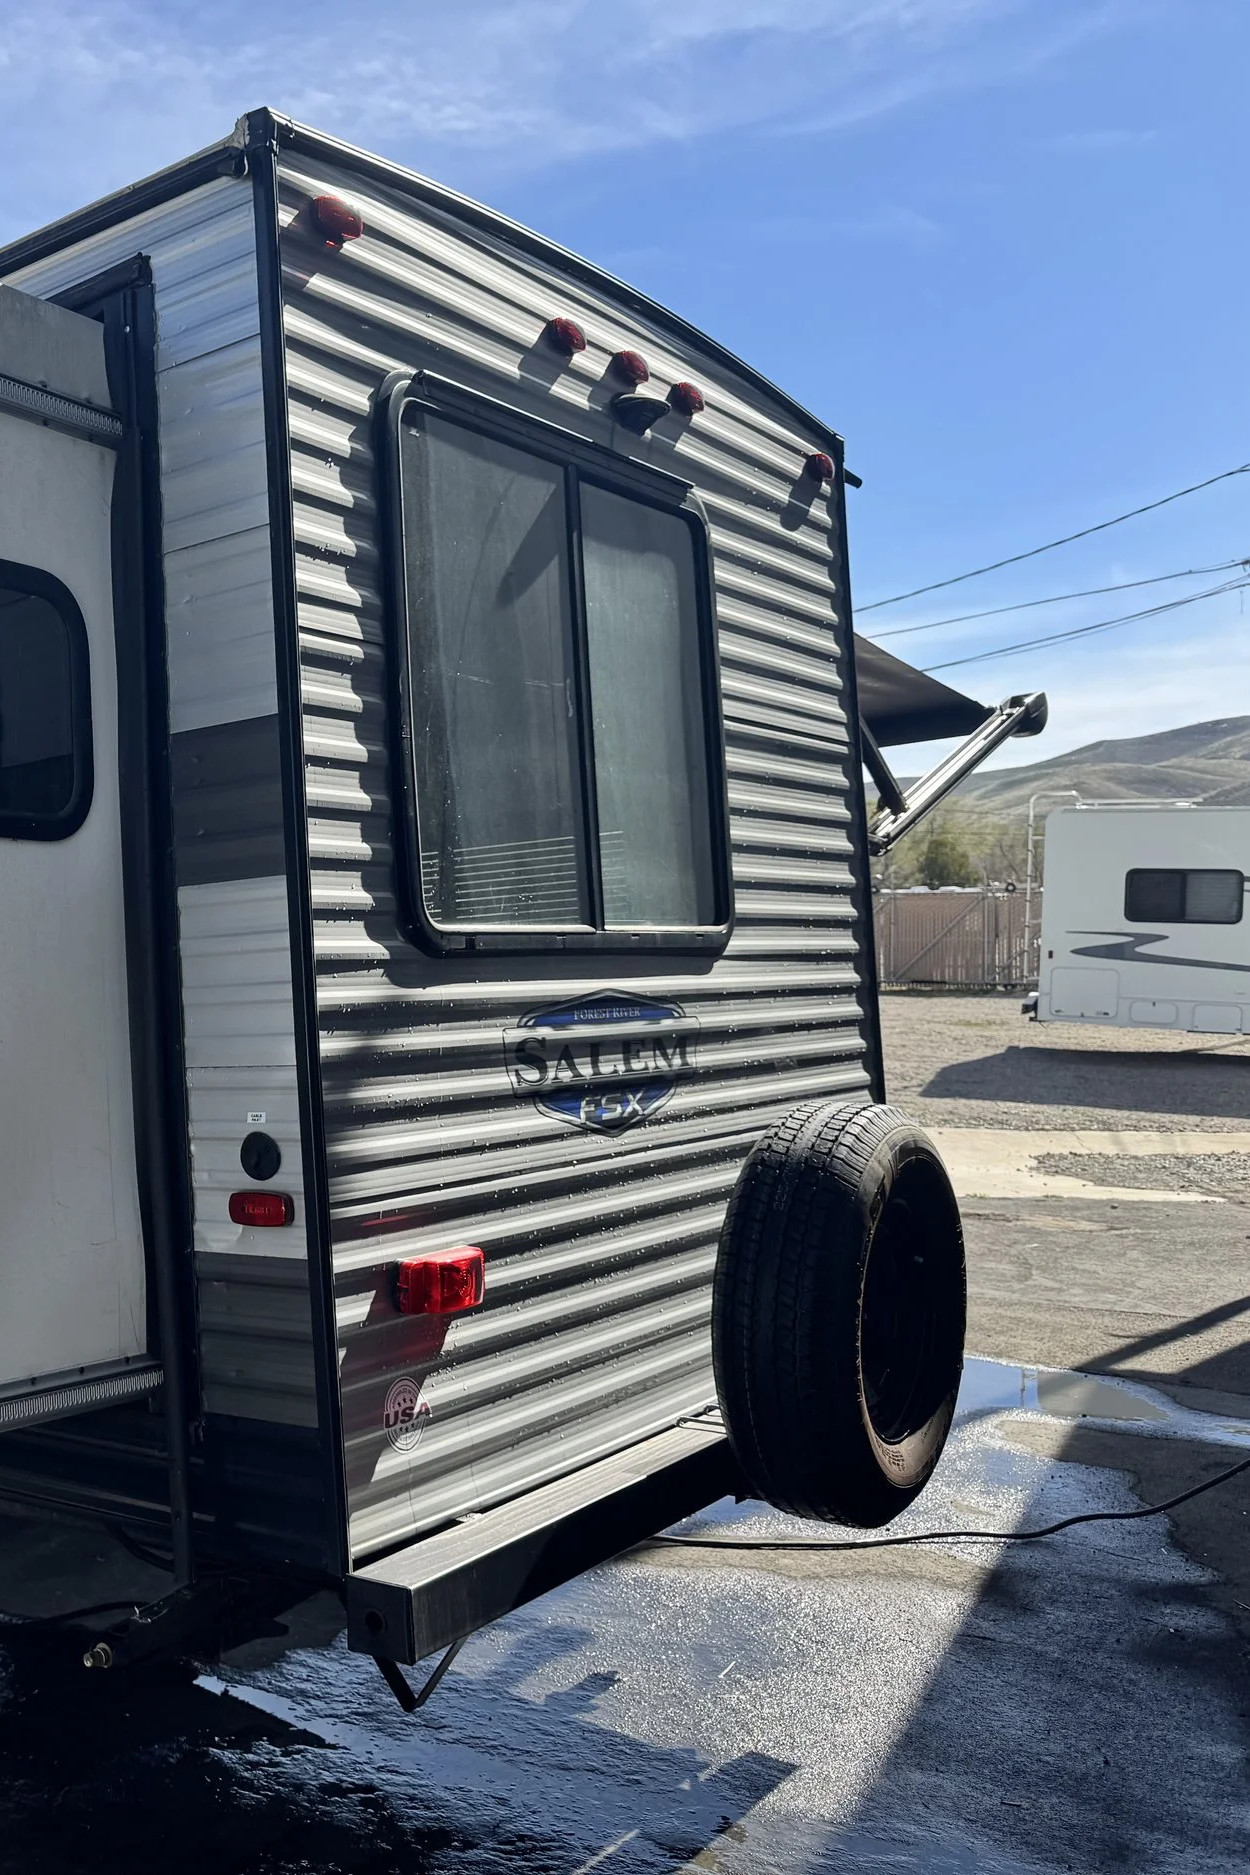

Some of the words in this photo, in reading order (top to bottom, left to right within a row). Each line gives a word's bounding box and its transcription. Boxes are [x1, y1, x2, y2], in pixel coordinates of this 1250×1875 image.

[573, 1008, 611, 1021] FOREST
[612, 1006, 641, 1018] RIVER
[515, 1036, 691, 1086] SALEM
[581, 1089, 645, 1124] FSX
[385, 1402, 432, 1429] USA
